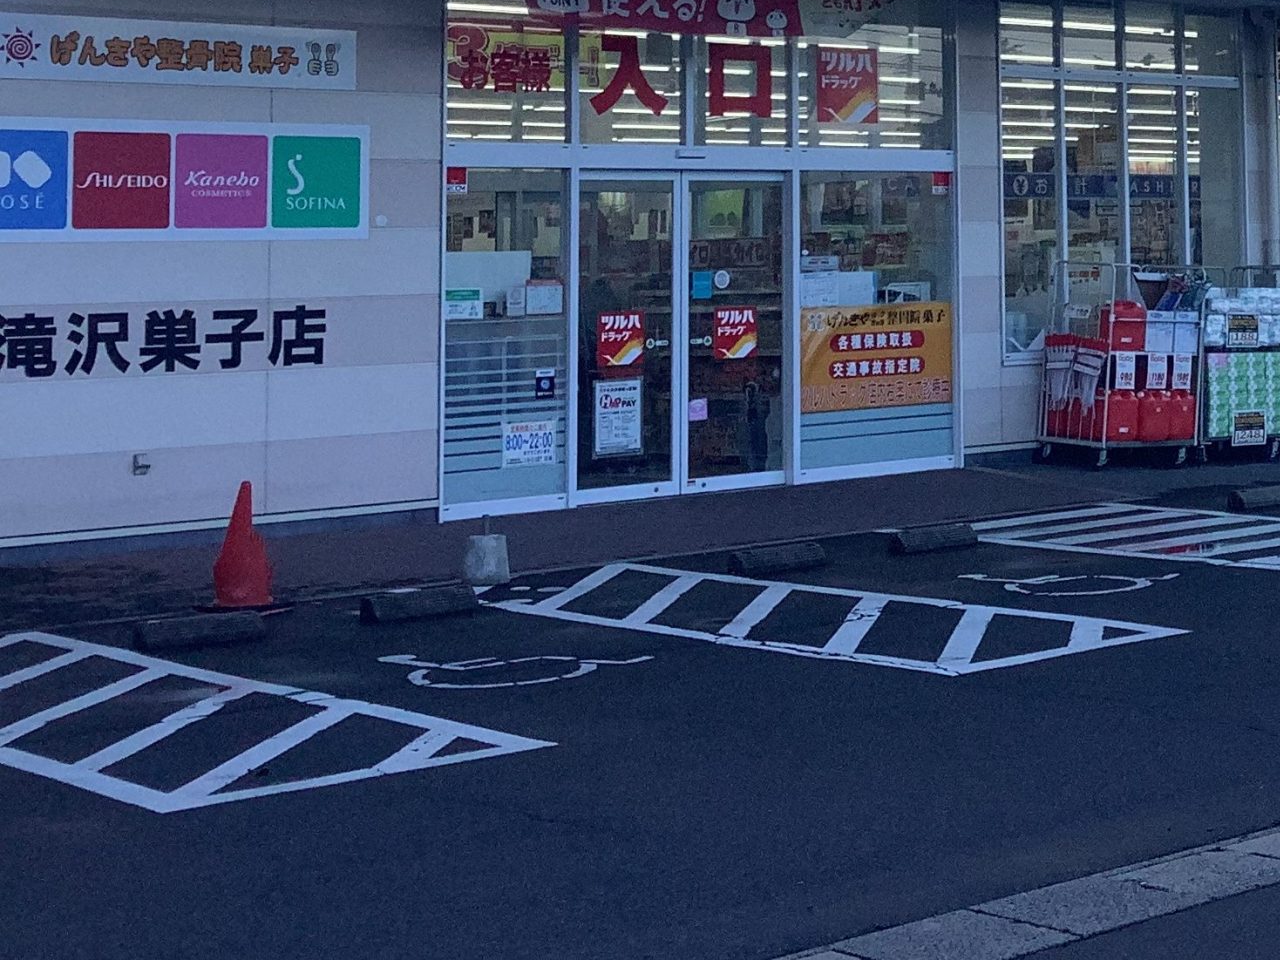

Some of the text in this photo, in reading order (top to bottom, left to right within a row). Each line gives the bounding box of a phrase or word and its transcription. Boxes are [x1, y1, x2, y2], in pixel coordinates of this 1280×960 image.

[249, 44, 299, 74] 巣子
[821, 52, 873, 73] ツルハ
[589, 34, 772, 118] 入口
[821, 74, 862, 89] ドラッグ
[76, 171, 169, 190] SHISEIDO
[184, 170, 260, 188] Kanebo
[0, 193, 45, 210] OSÉ
[286, 196, 346, 211] SOFINA
[601, 314, 641, 329] ツルハ
[717, 309, 754, 325] ツルハ
[601, 330, 632, 342] ドラッグ
[717, 325, 746, 337] ドラッグ
[0, 304, 327, 378] 滝沢巣子店
[838, 332, 913, 351] 各種保険取扱
[833, 357, 921, 378] 交通事故指定院
